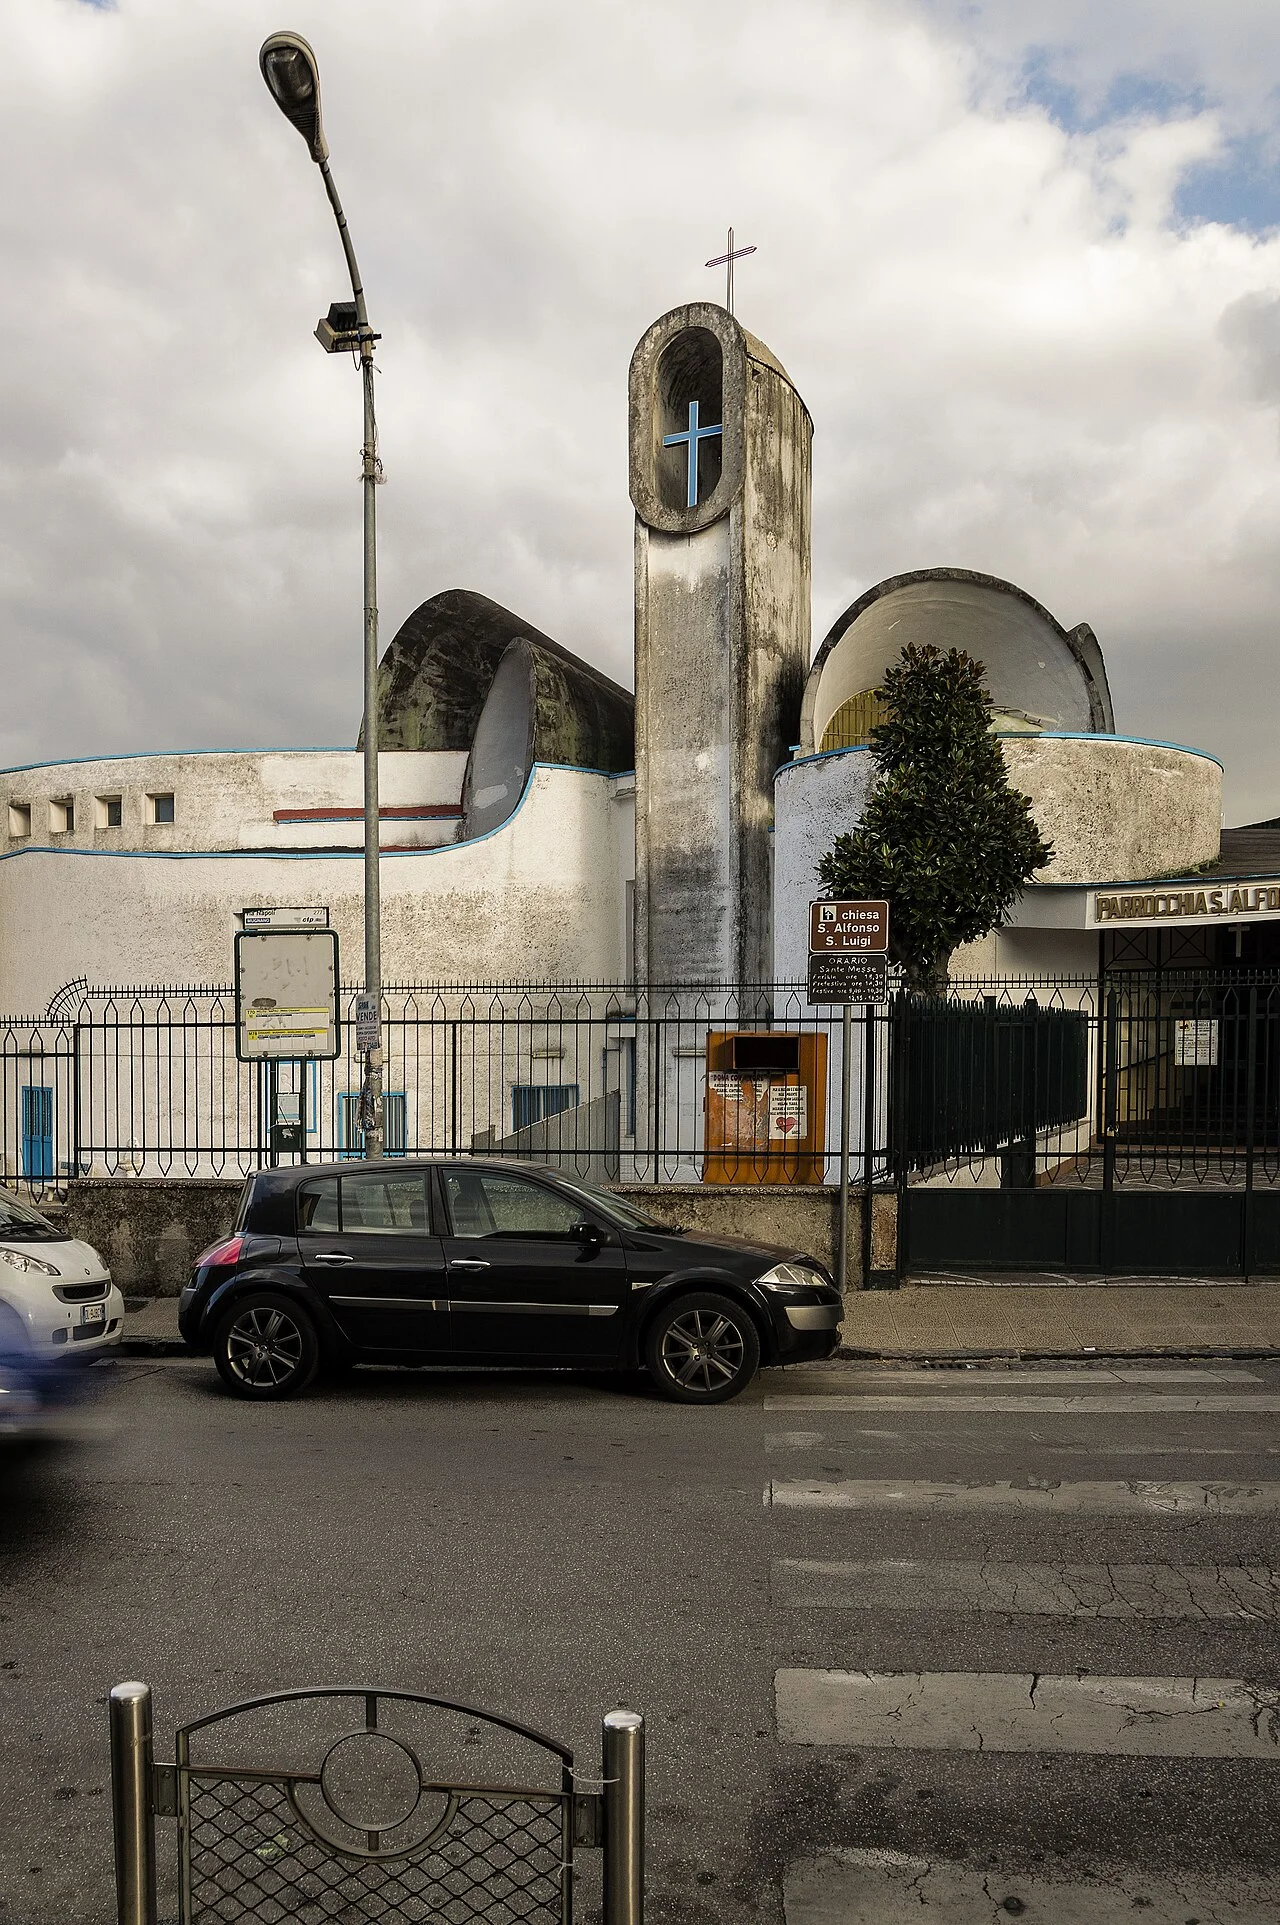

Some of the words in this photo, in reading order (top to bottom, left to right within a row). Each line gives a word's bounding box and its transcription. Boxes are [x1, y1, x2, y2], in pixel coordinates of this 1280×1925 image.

[1097, 892, 1207, 919] PARROCCHIA
[1209, 891, 1228, 914] S.
[841, 909, 880, 920] chiesa
[817, 923, 830, 933] S.
[834, 922, 880, 933] Alfonso
[825, 935, 838, 946] S.
[842, 935, 871, 948] Luigi
[828, 956, 868, 965] ORARIO
[819, 965, 845, 973] Sante
[847, 965, 877, 973] Messe
[356, 1011, 377, 1021] VENDE
